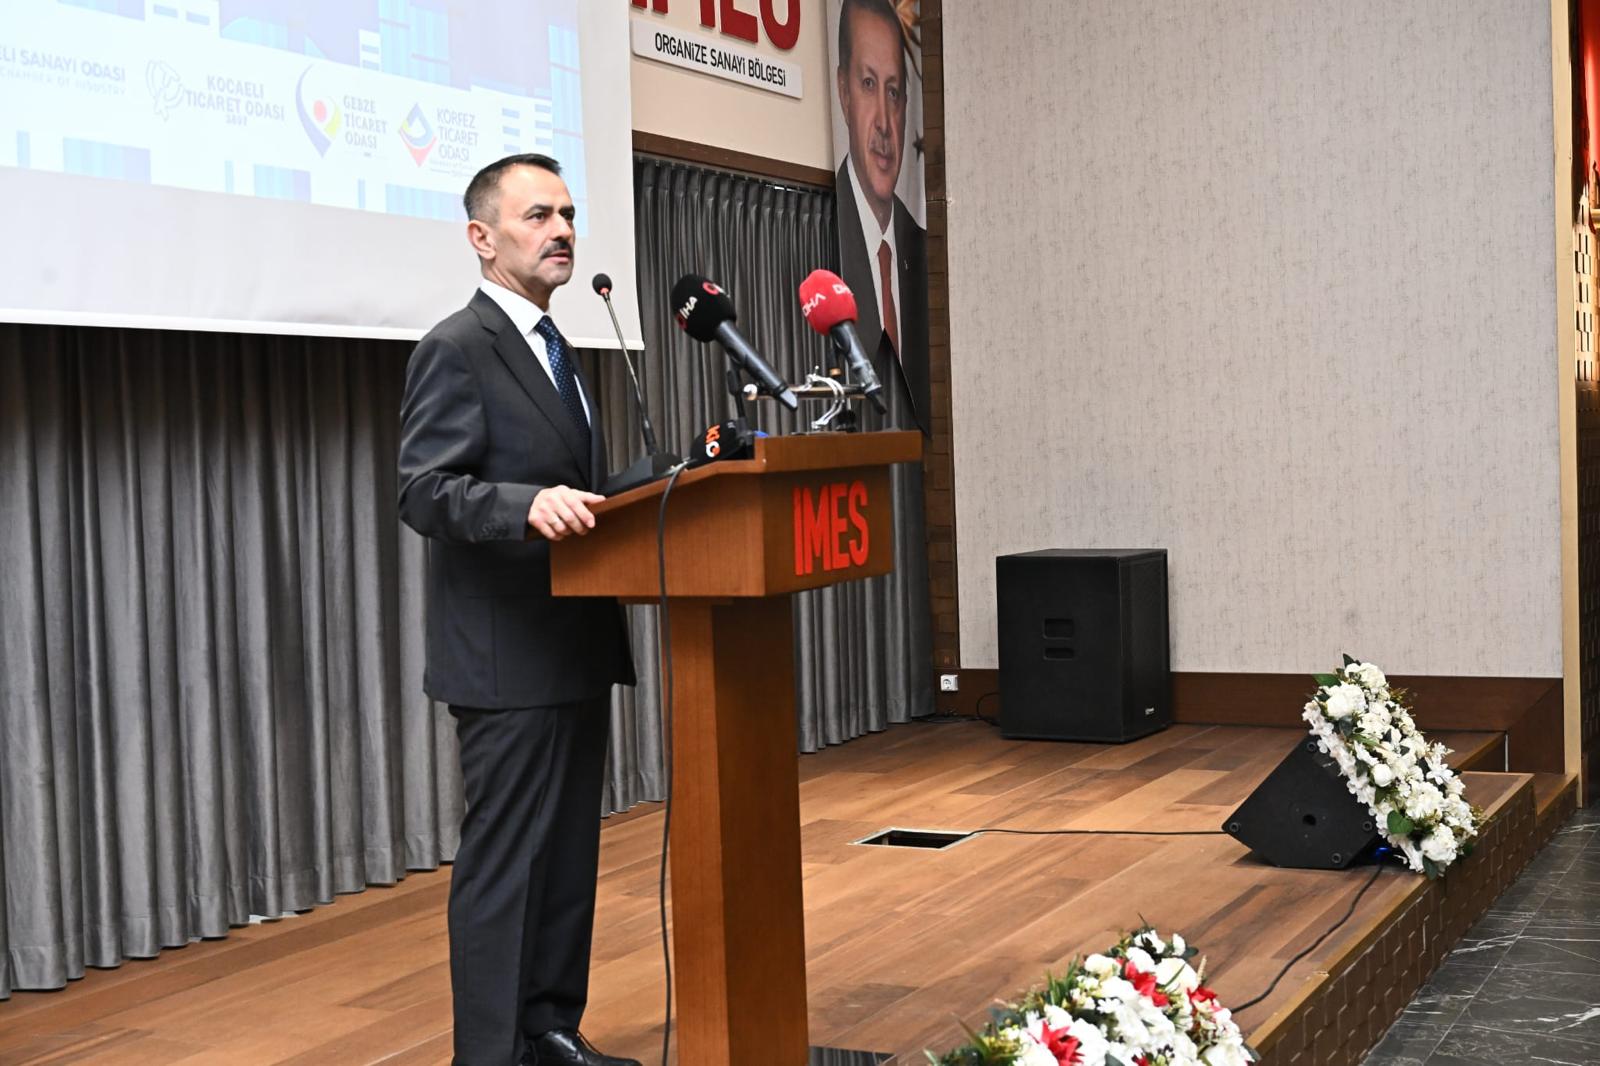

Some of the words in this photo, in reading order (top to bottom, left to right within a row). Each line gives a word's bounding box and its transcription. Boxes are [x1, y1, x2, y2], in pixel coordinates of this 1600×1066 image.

[80, 60, 126, 83] ODASI
[245, 100, 285, 121] ODASI
[343, 95, 377, 114] GEBZE
[345, 131, 377, 149] ODASI
[439, 143, 470, 162] ODASI
[793, 480, 869, 576] IMES
